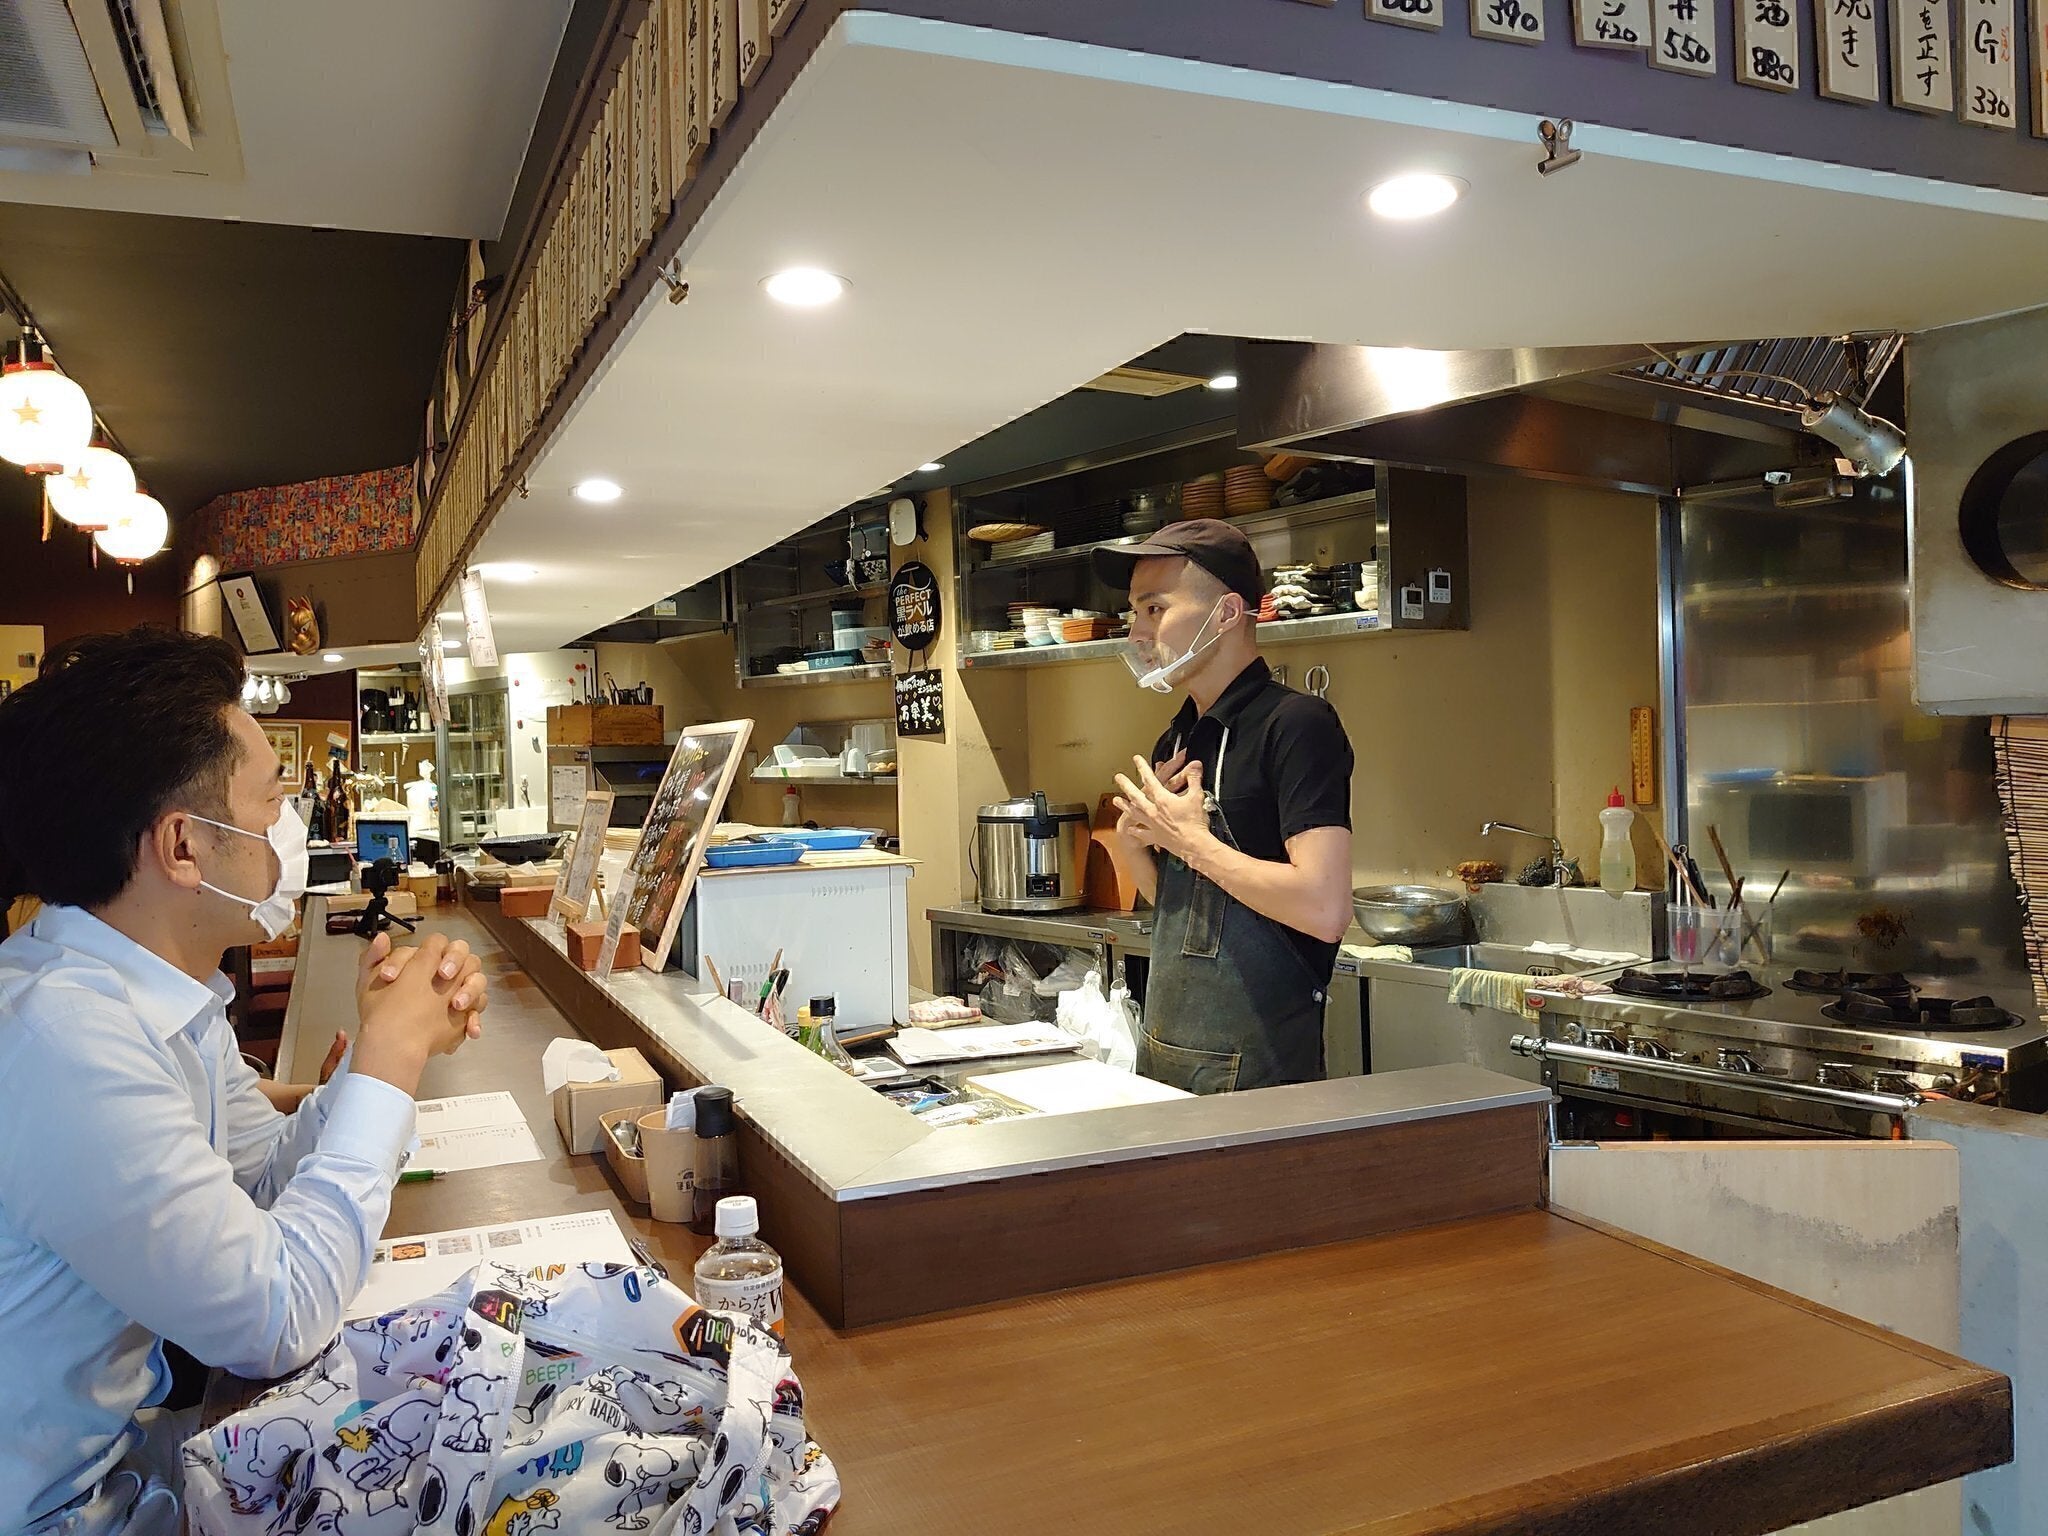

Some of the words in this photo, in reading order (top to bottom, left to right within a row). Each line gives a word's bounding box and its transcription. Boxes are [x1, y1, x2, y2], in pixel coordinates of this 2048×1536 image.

[1594, 16, 1639, 43] 420
[1663, 27, 1711, 64] 550
[1917, 0, 1940, 97] を正す
[1971, 85, 2011, 118] 330
[895, 589, 931, 607] PERFECT
[896, 600, 933, 623] 黒ラベル
[897, 618, 935, 638] が飲める店
[719, 1291, 768, 1311] からだ
[525, 1364, 576, 1386] BEEP!
[589, 1397, 622, 1429] HARD
